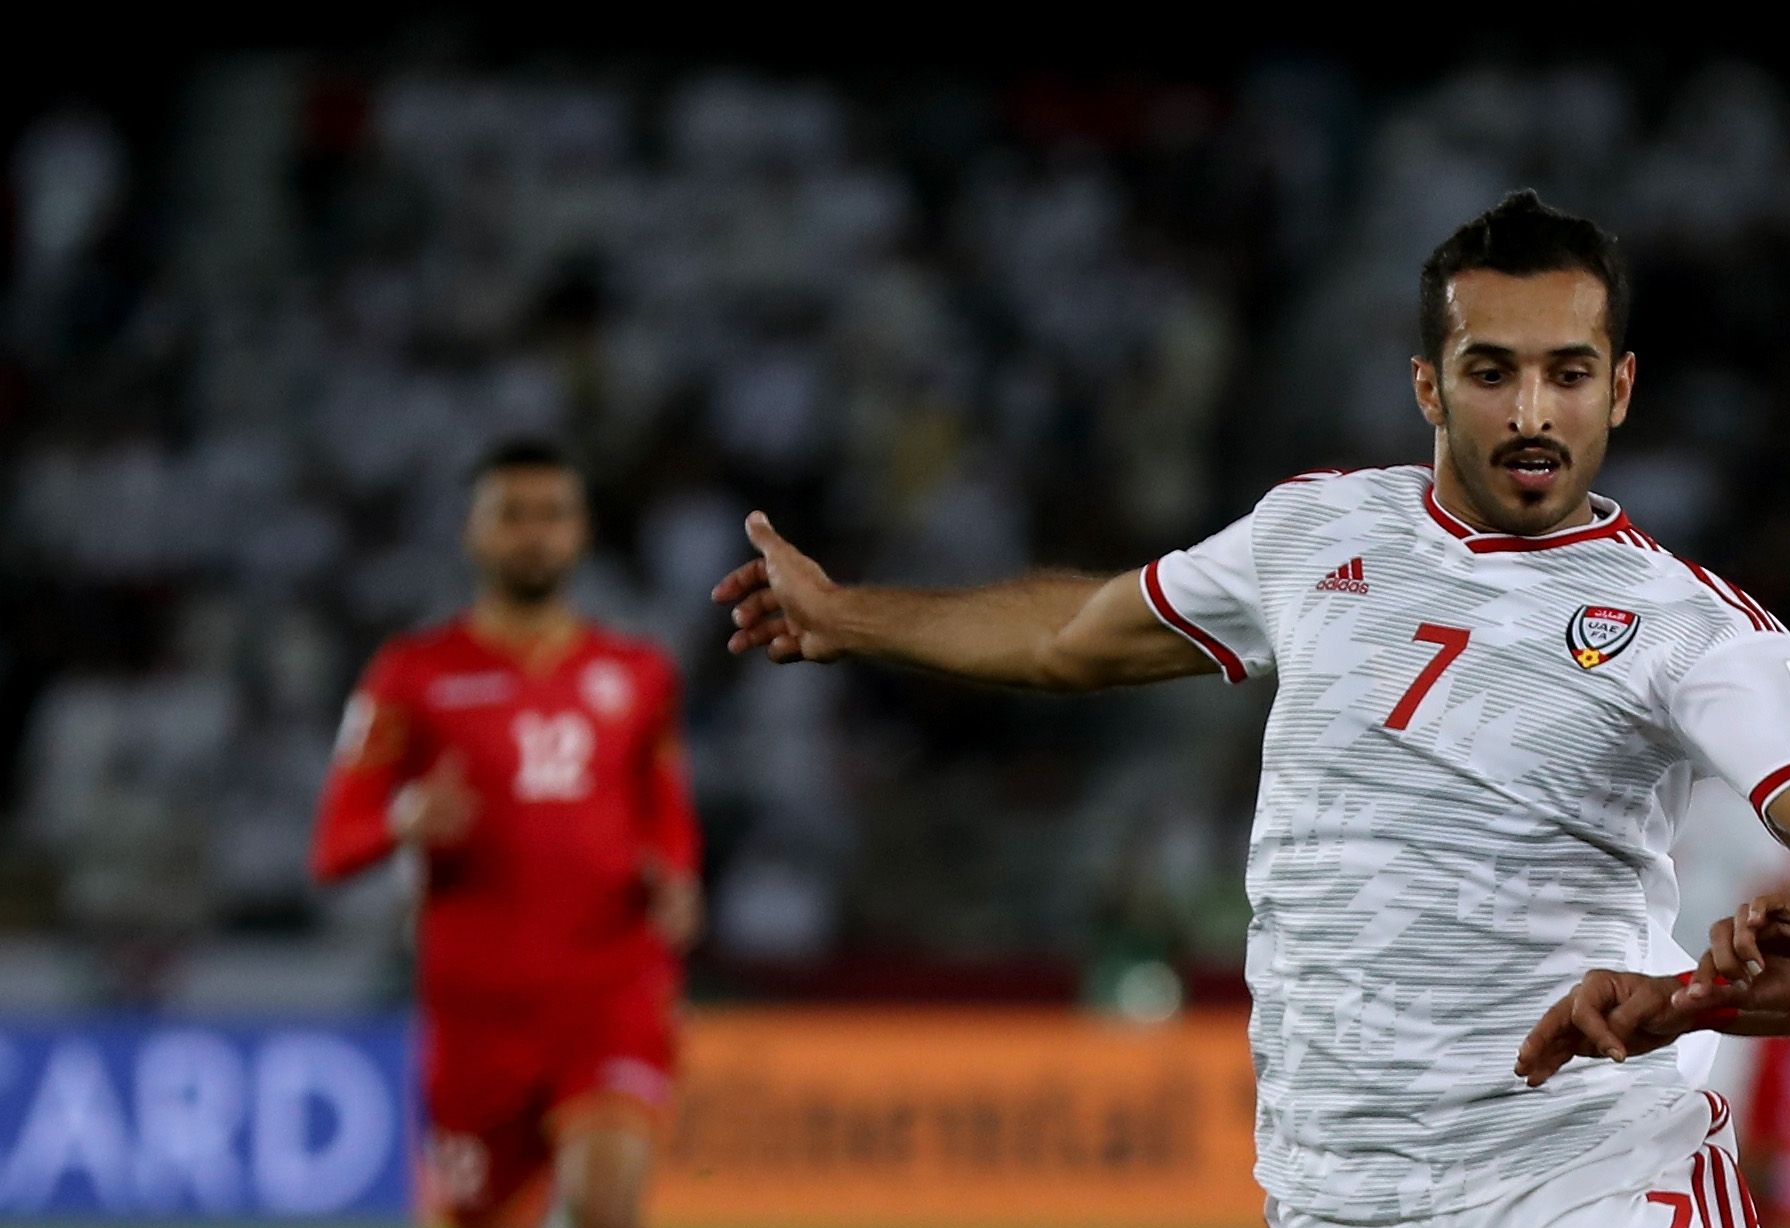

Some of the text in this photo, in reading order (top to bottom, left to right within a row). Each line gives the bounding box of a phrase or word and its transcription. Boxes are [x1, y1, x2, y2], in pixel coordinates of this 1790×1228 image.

[1316, 576, 1369, 595] adidas
[1588, 621, 1620, 634] UAE
[1590, 630, 1608, 641] FA
[1383, 621, 1471, 731] 7
[0, 1028, 397, 1212] ARD
